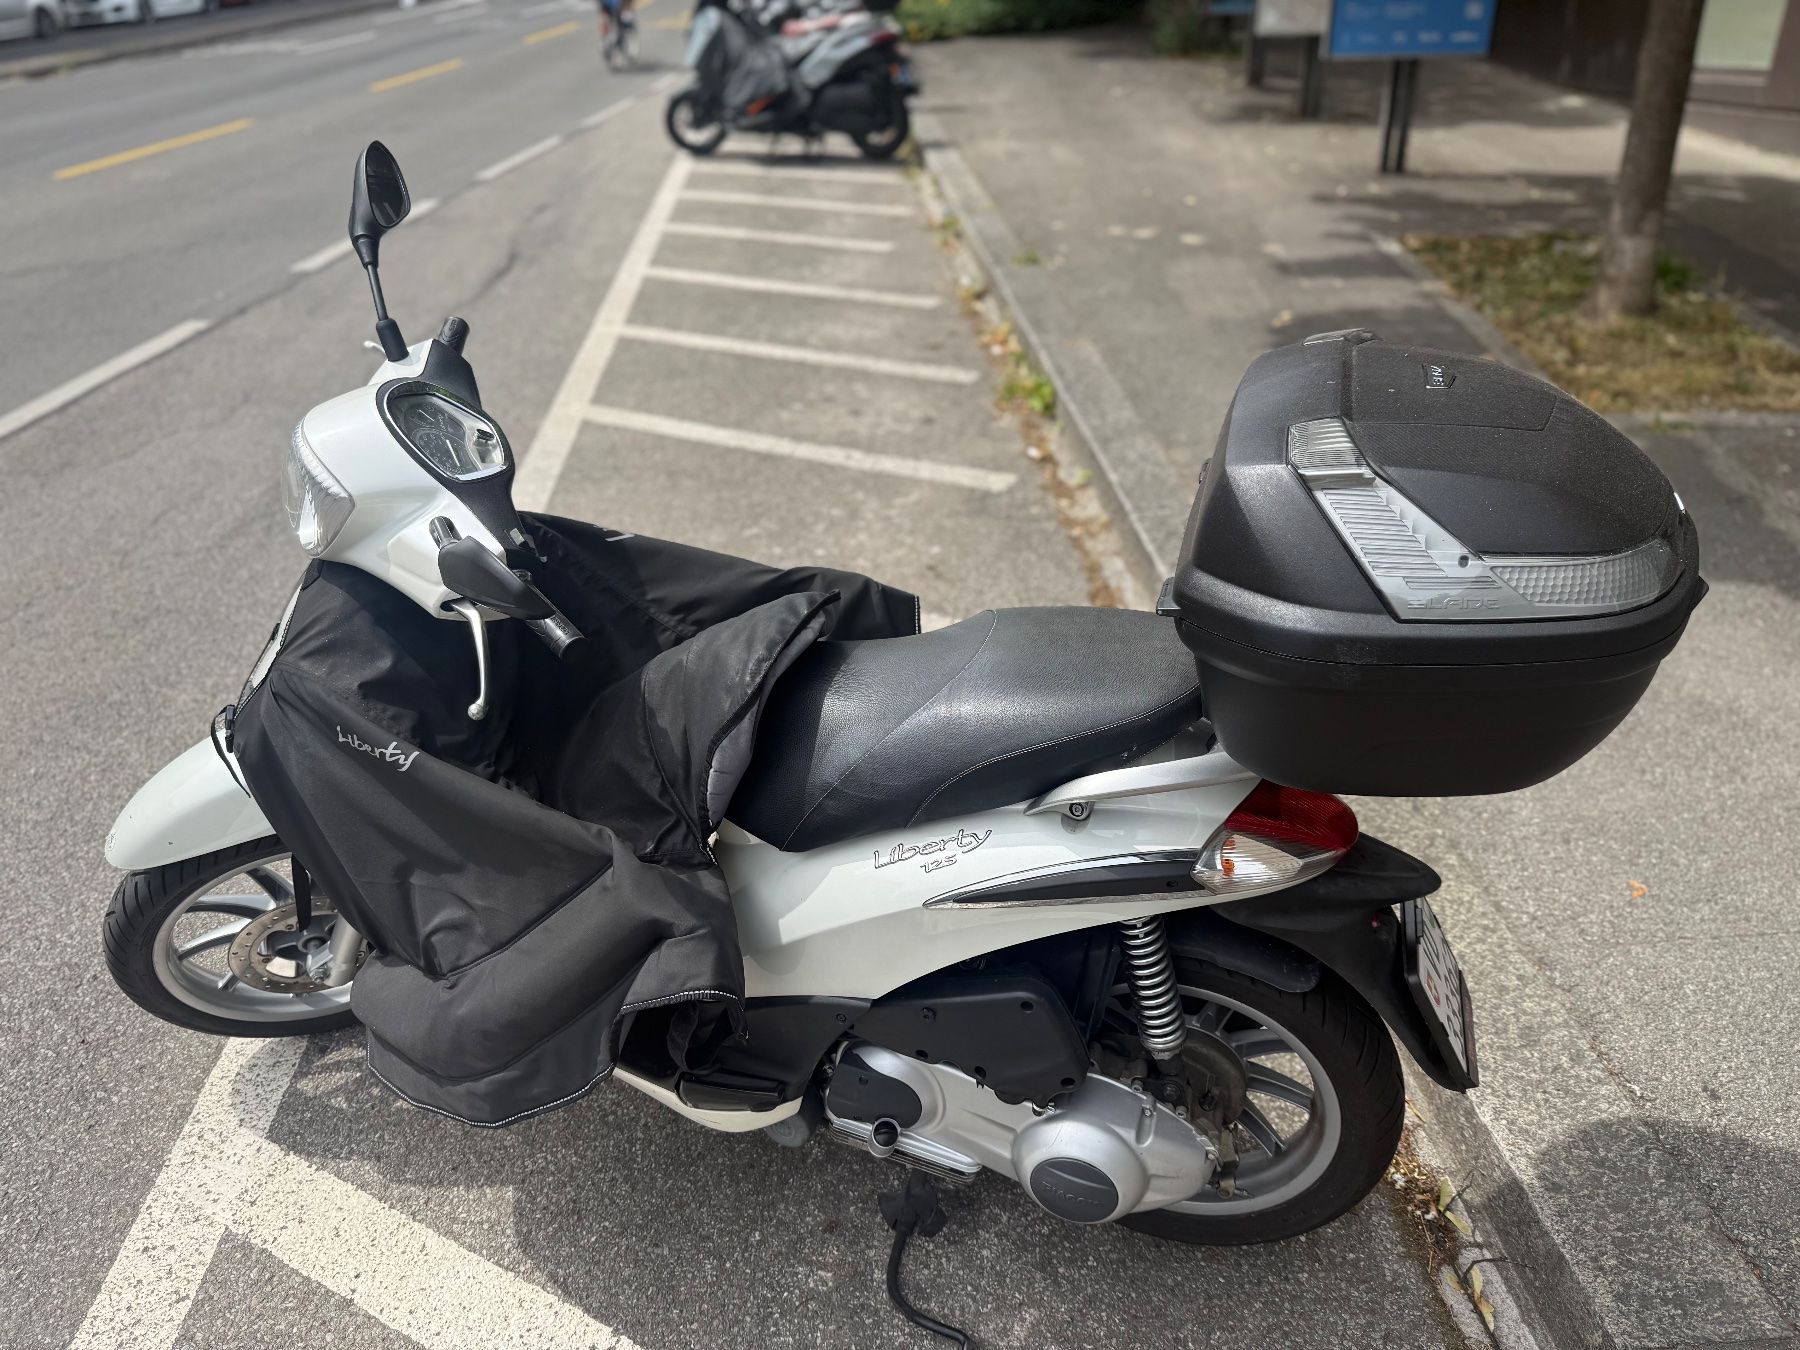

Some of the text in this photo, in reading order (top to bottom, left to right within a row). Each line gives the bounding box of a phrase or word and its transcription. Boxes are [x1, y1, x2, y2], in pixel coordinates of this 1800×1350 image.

[336, 725, 420, 772] Liberty
[874, 828, 993, 869] Liberty
[919, 853, 958, 873] 125
